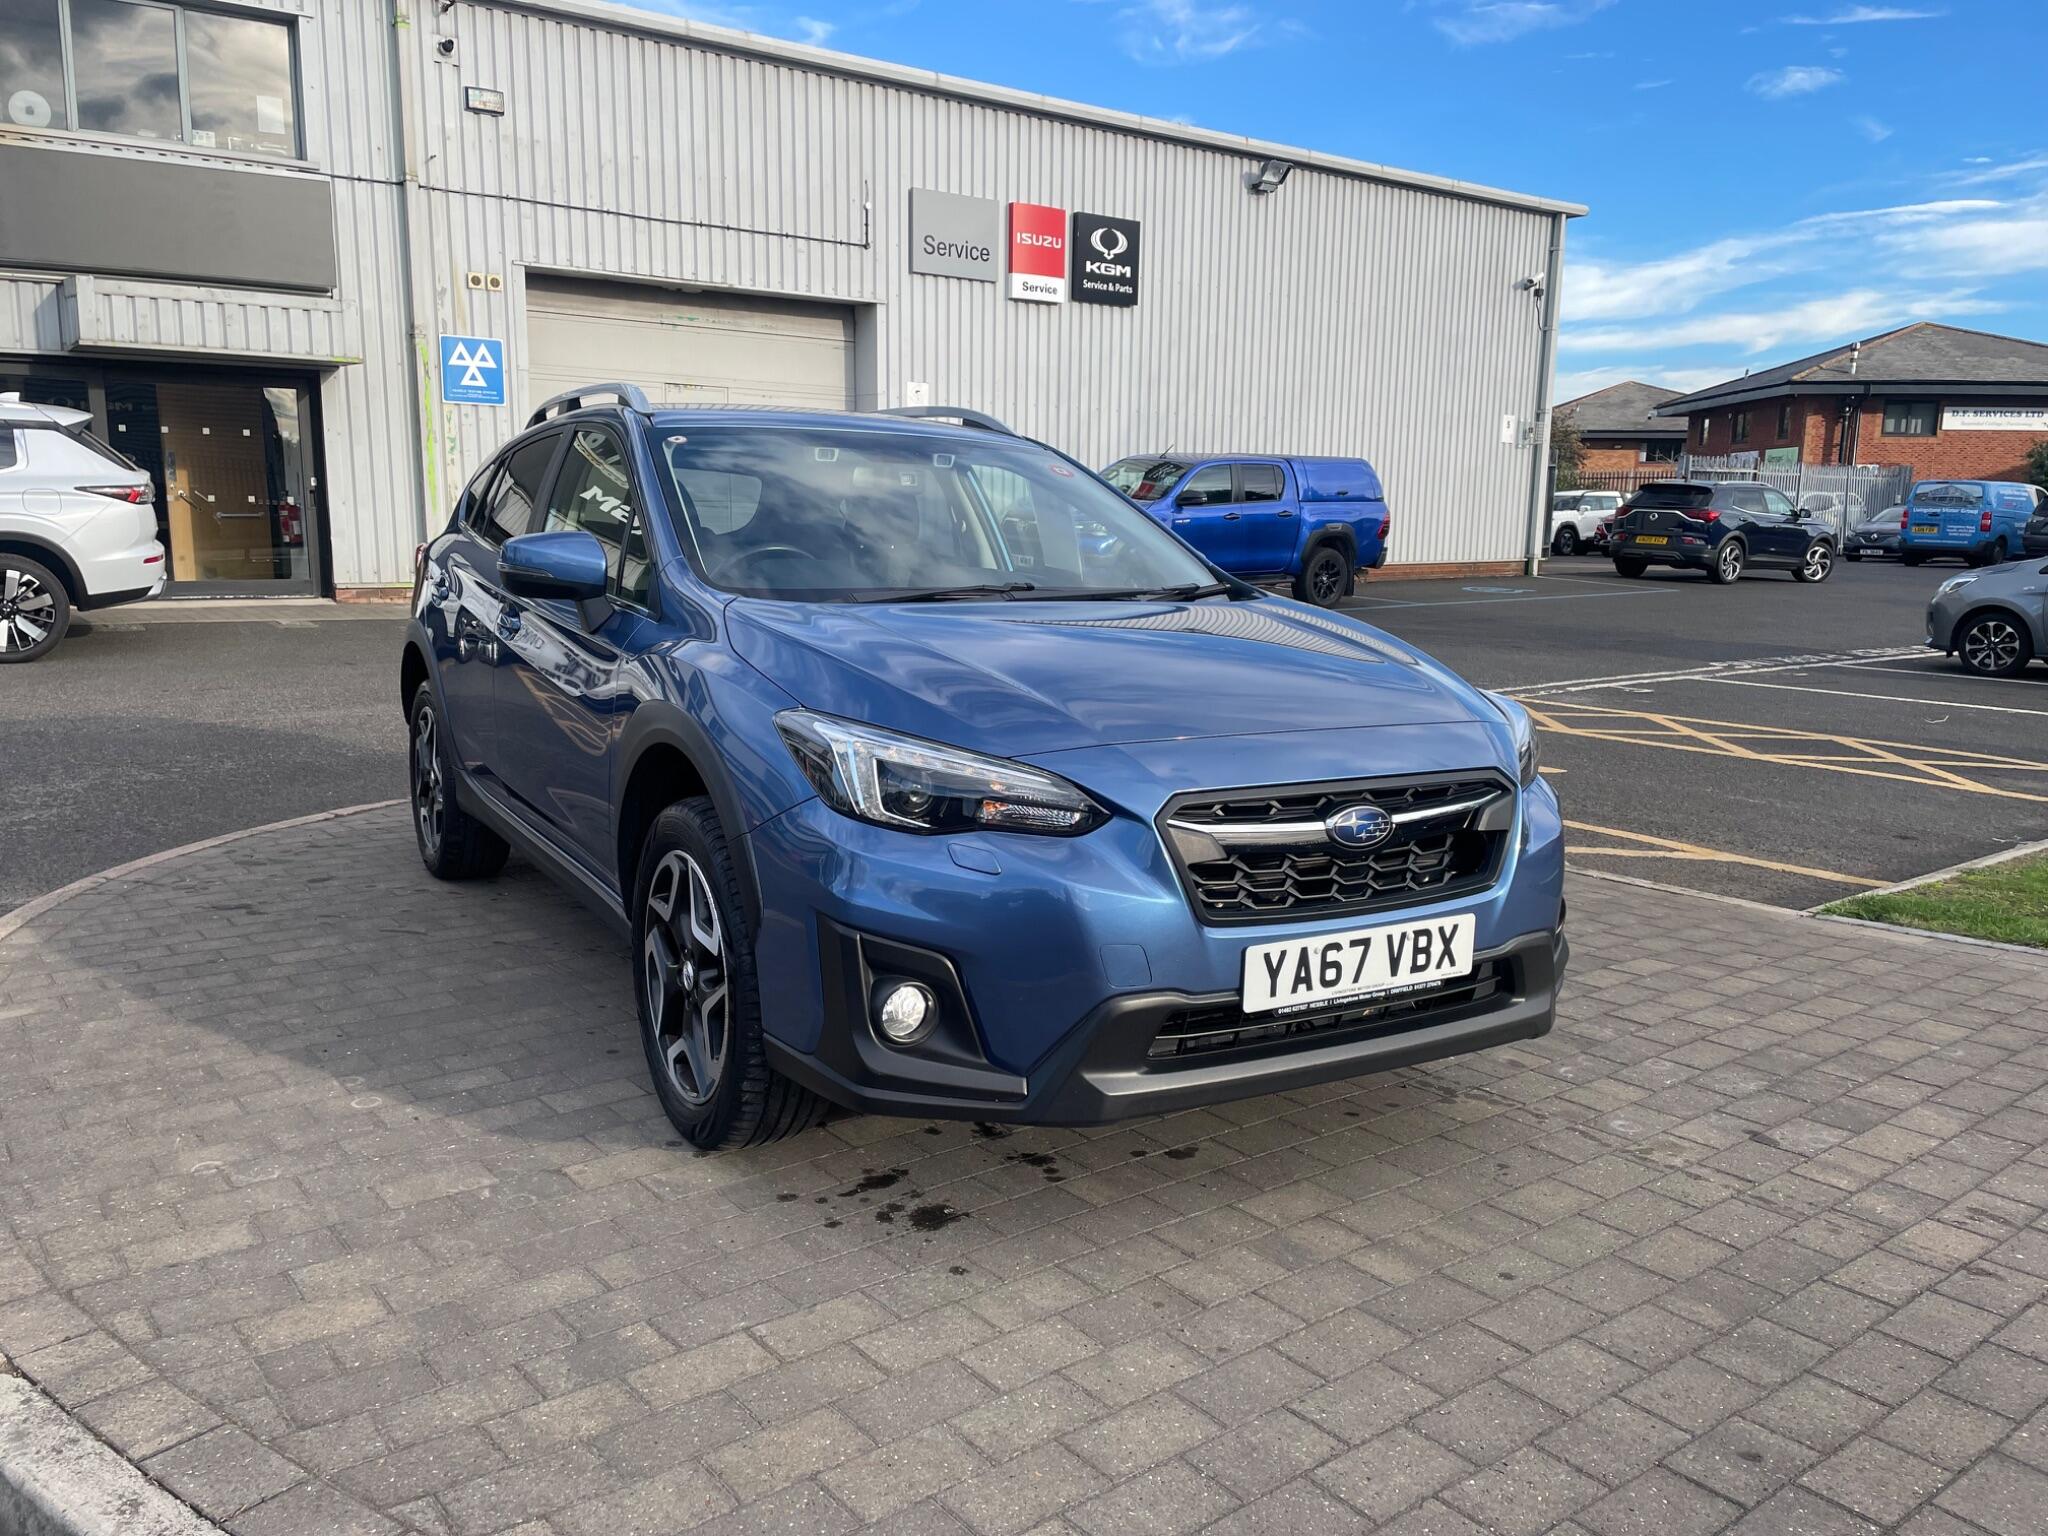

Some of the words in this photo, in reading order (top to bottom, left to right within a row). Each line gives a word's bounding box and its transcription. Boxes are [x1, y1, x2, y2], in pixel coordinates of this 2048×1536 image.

[923, 234, 990, 262] Service
[1016, 232, 1062, 249] ISUZU
[1085, 260, 1132, 278] KGM
[1022, 281, 1058, 295] Service
[1083, 279, 1107, 292] Service
[1108, 282, 1114, 292] &
[1115, 282, 1133, 294] Parts
[1972, 409, 2022, 418] SERVICES
[2025, 410, 2045, 418] LTD
[1263, 936, 1372, 998] YA67
[1386, 923, 1459, 978] VBX
